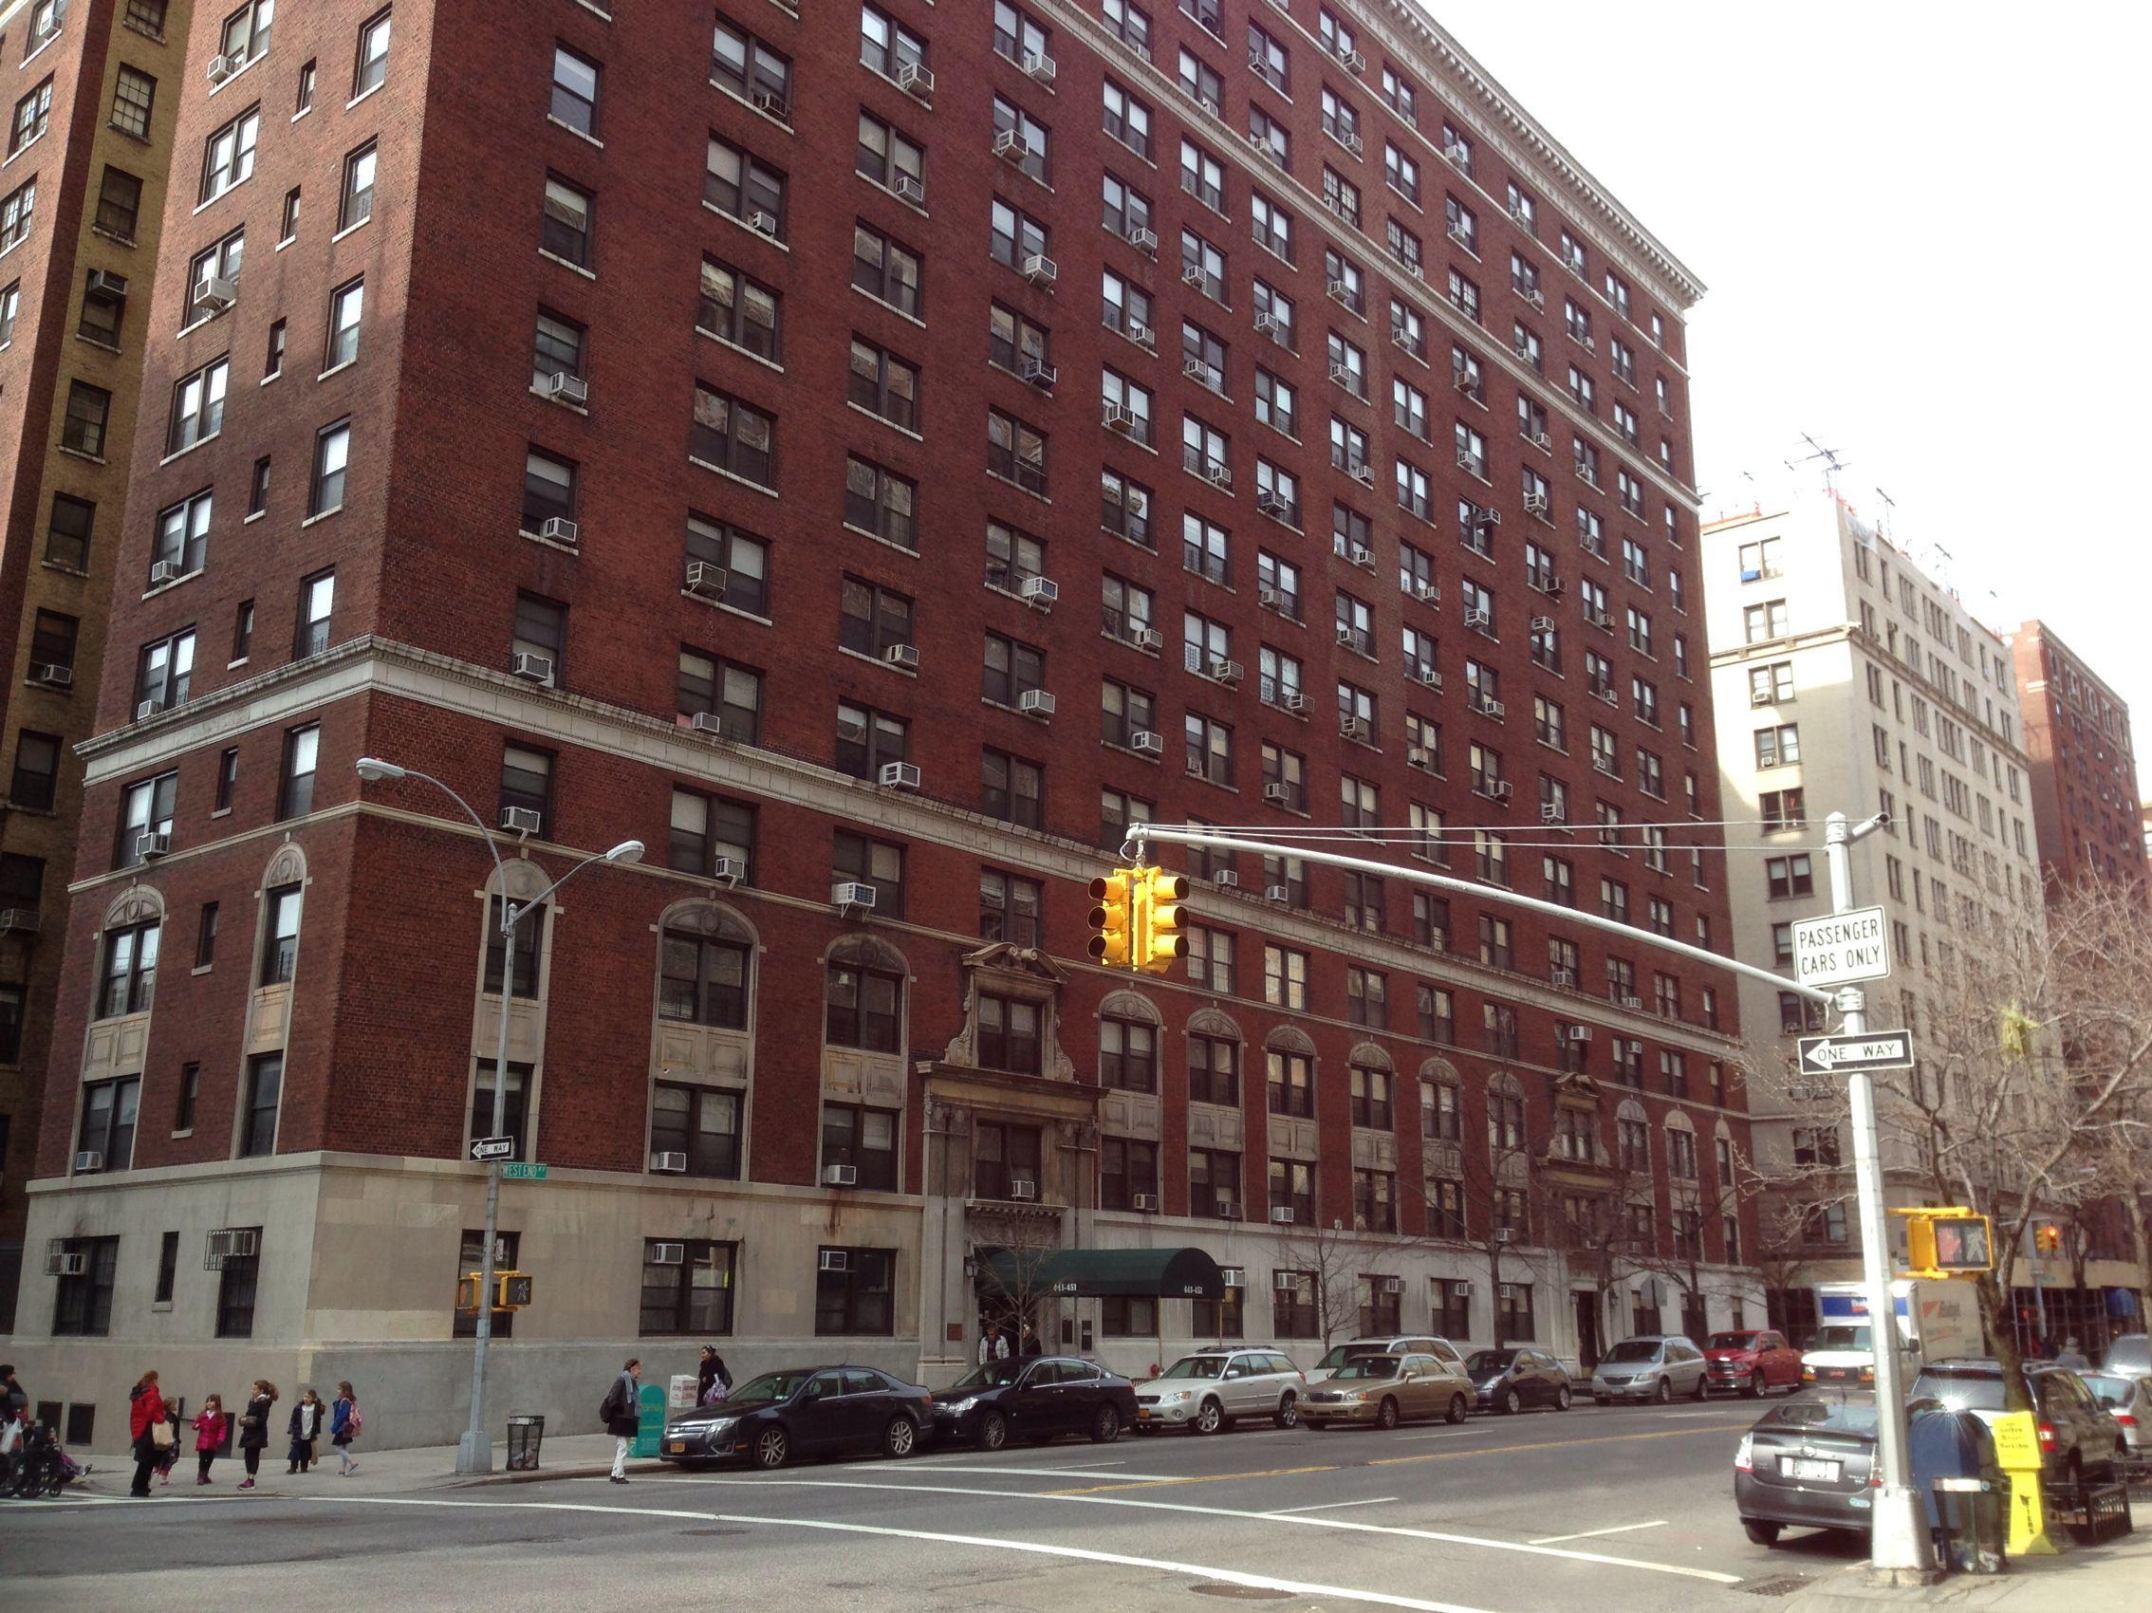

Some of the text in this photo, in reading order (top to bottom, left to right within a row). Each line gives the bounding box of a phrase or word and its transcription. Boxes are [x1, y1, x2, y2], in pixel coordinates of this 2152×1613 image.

[1799, 918, 1878, 949] PASSENGER
[1801, 945, 1880, 975] CARS ONLY
[1817, 1043, 1895, 1062] ONE WAY
[475, 1143, 507, 1155] ONE WAY
[503, 1164, 522, 1177] WEST
[523, 1165, 537, 1177] END
